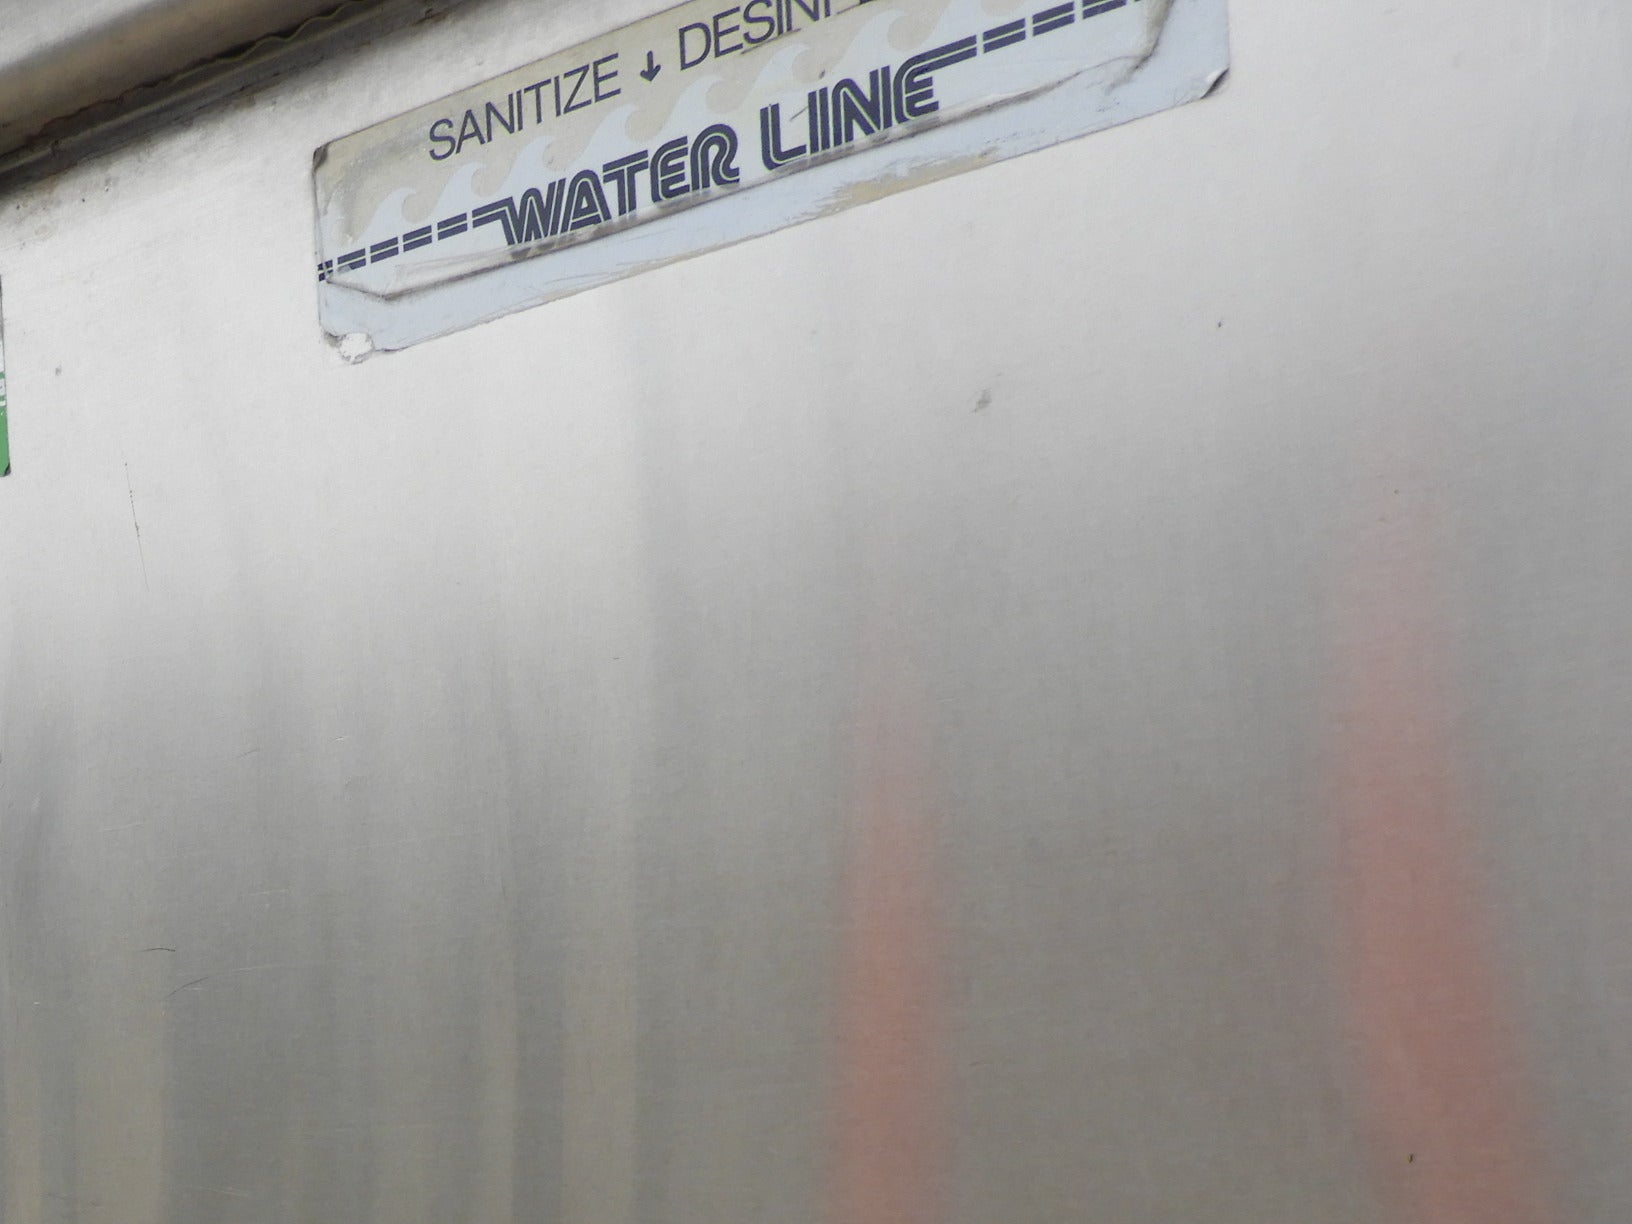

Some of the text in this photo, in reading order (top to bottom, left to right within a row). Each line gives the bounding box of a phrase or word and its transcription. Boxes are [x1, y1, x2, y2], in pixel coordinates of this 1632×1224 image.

[429, 0, 876, 161] SANITIZE DESIN
[472, 35, 977, 246] WATER LINE
